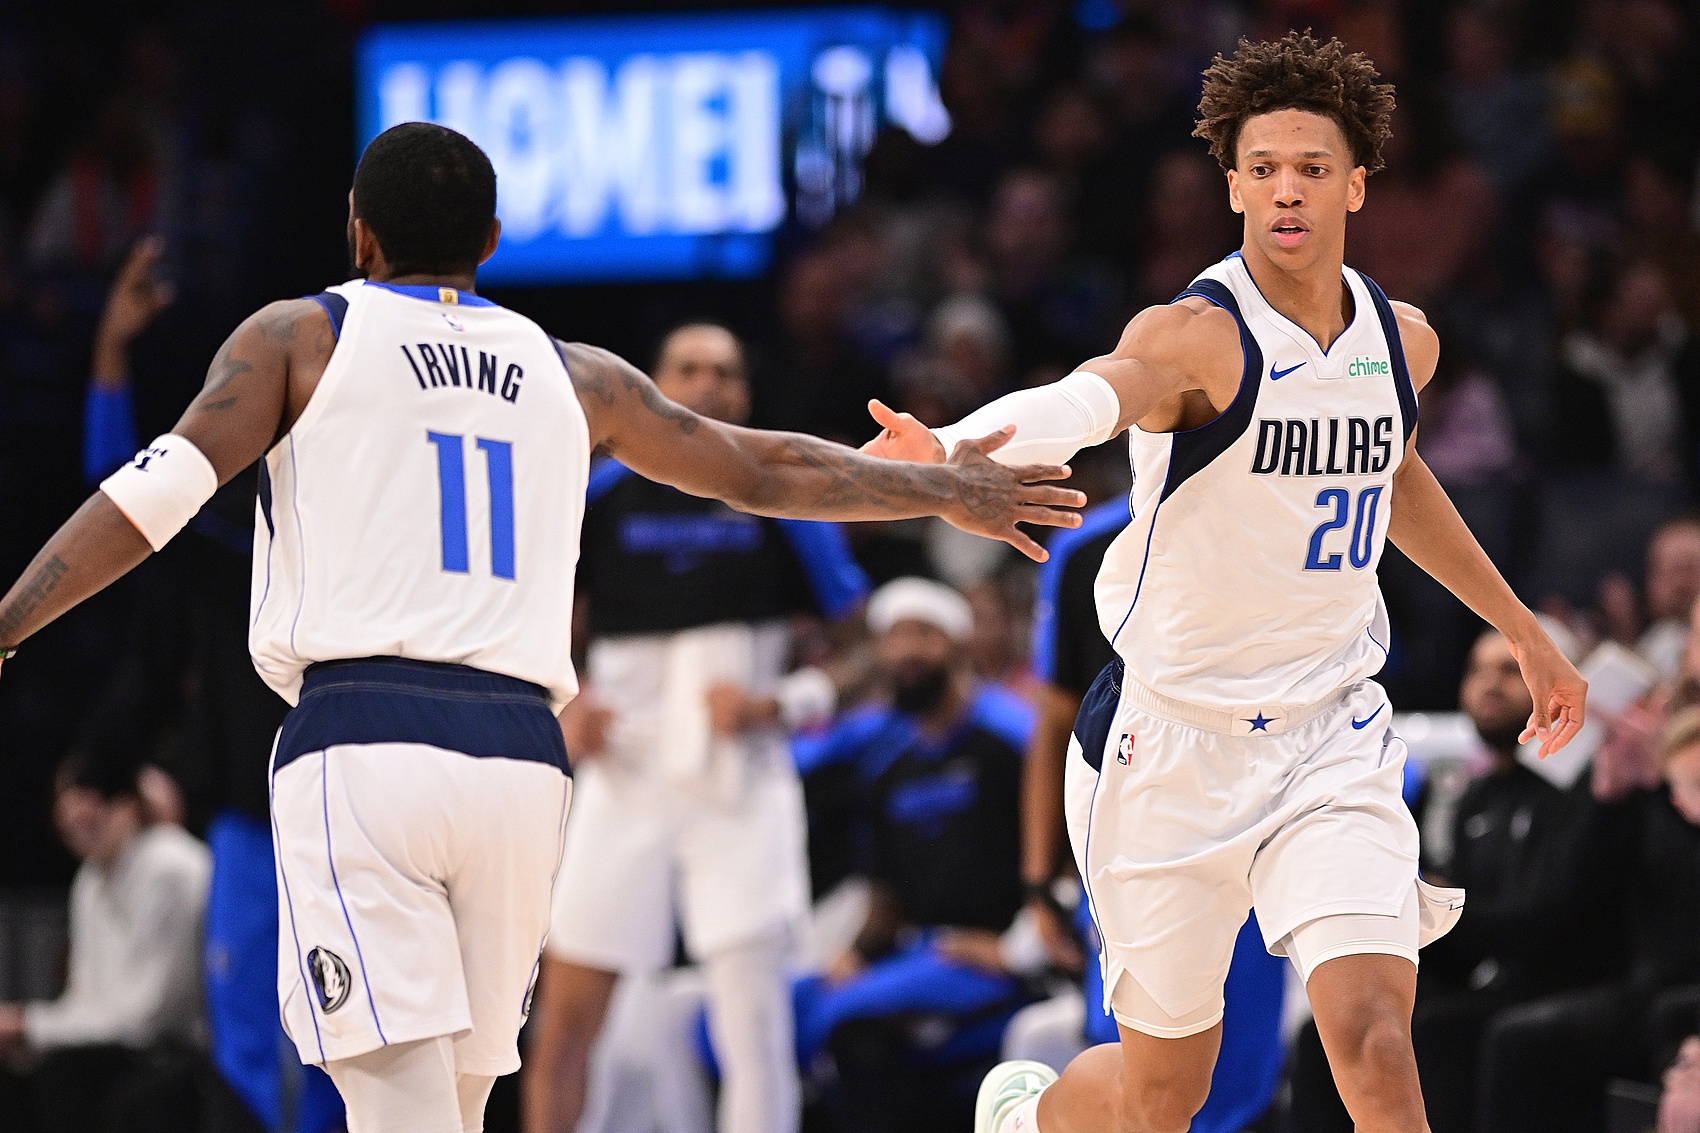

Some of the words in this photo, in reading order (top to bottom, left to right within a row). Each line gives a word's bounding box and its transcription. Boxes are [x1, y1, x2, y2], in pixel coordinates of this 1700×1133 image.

[400, 343, 524, 404] IRVING
[1349, 357, 1389, 376] chime
[1249, 414, 1394, 476] DALLAS
[426, 429, 518, 582] 11
[1303, 485, 1386, 571] 20
